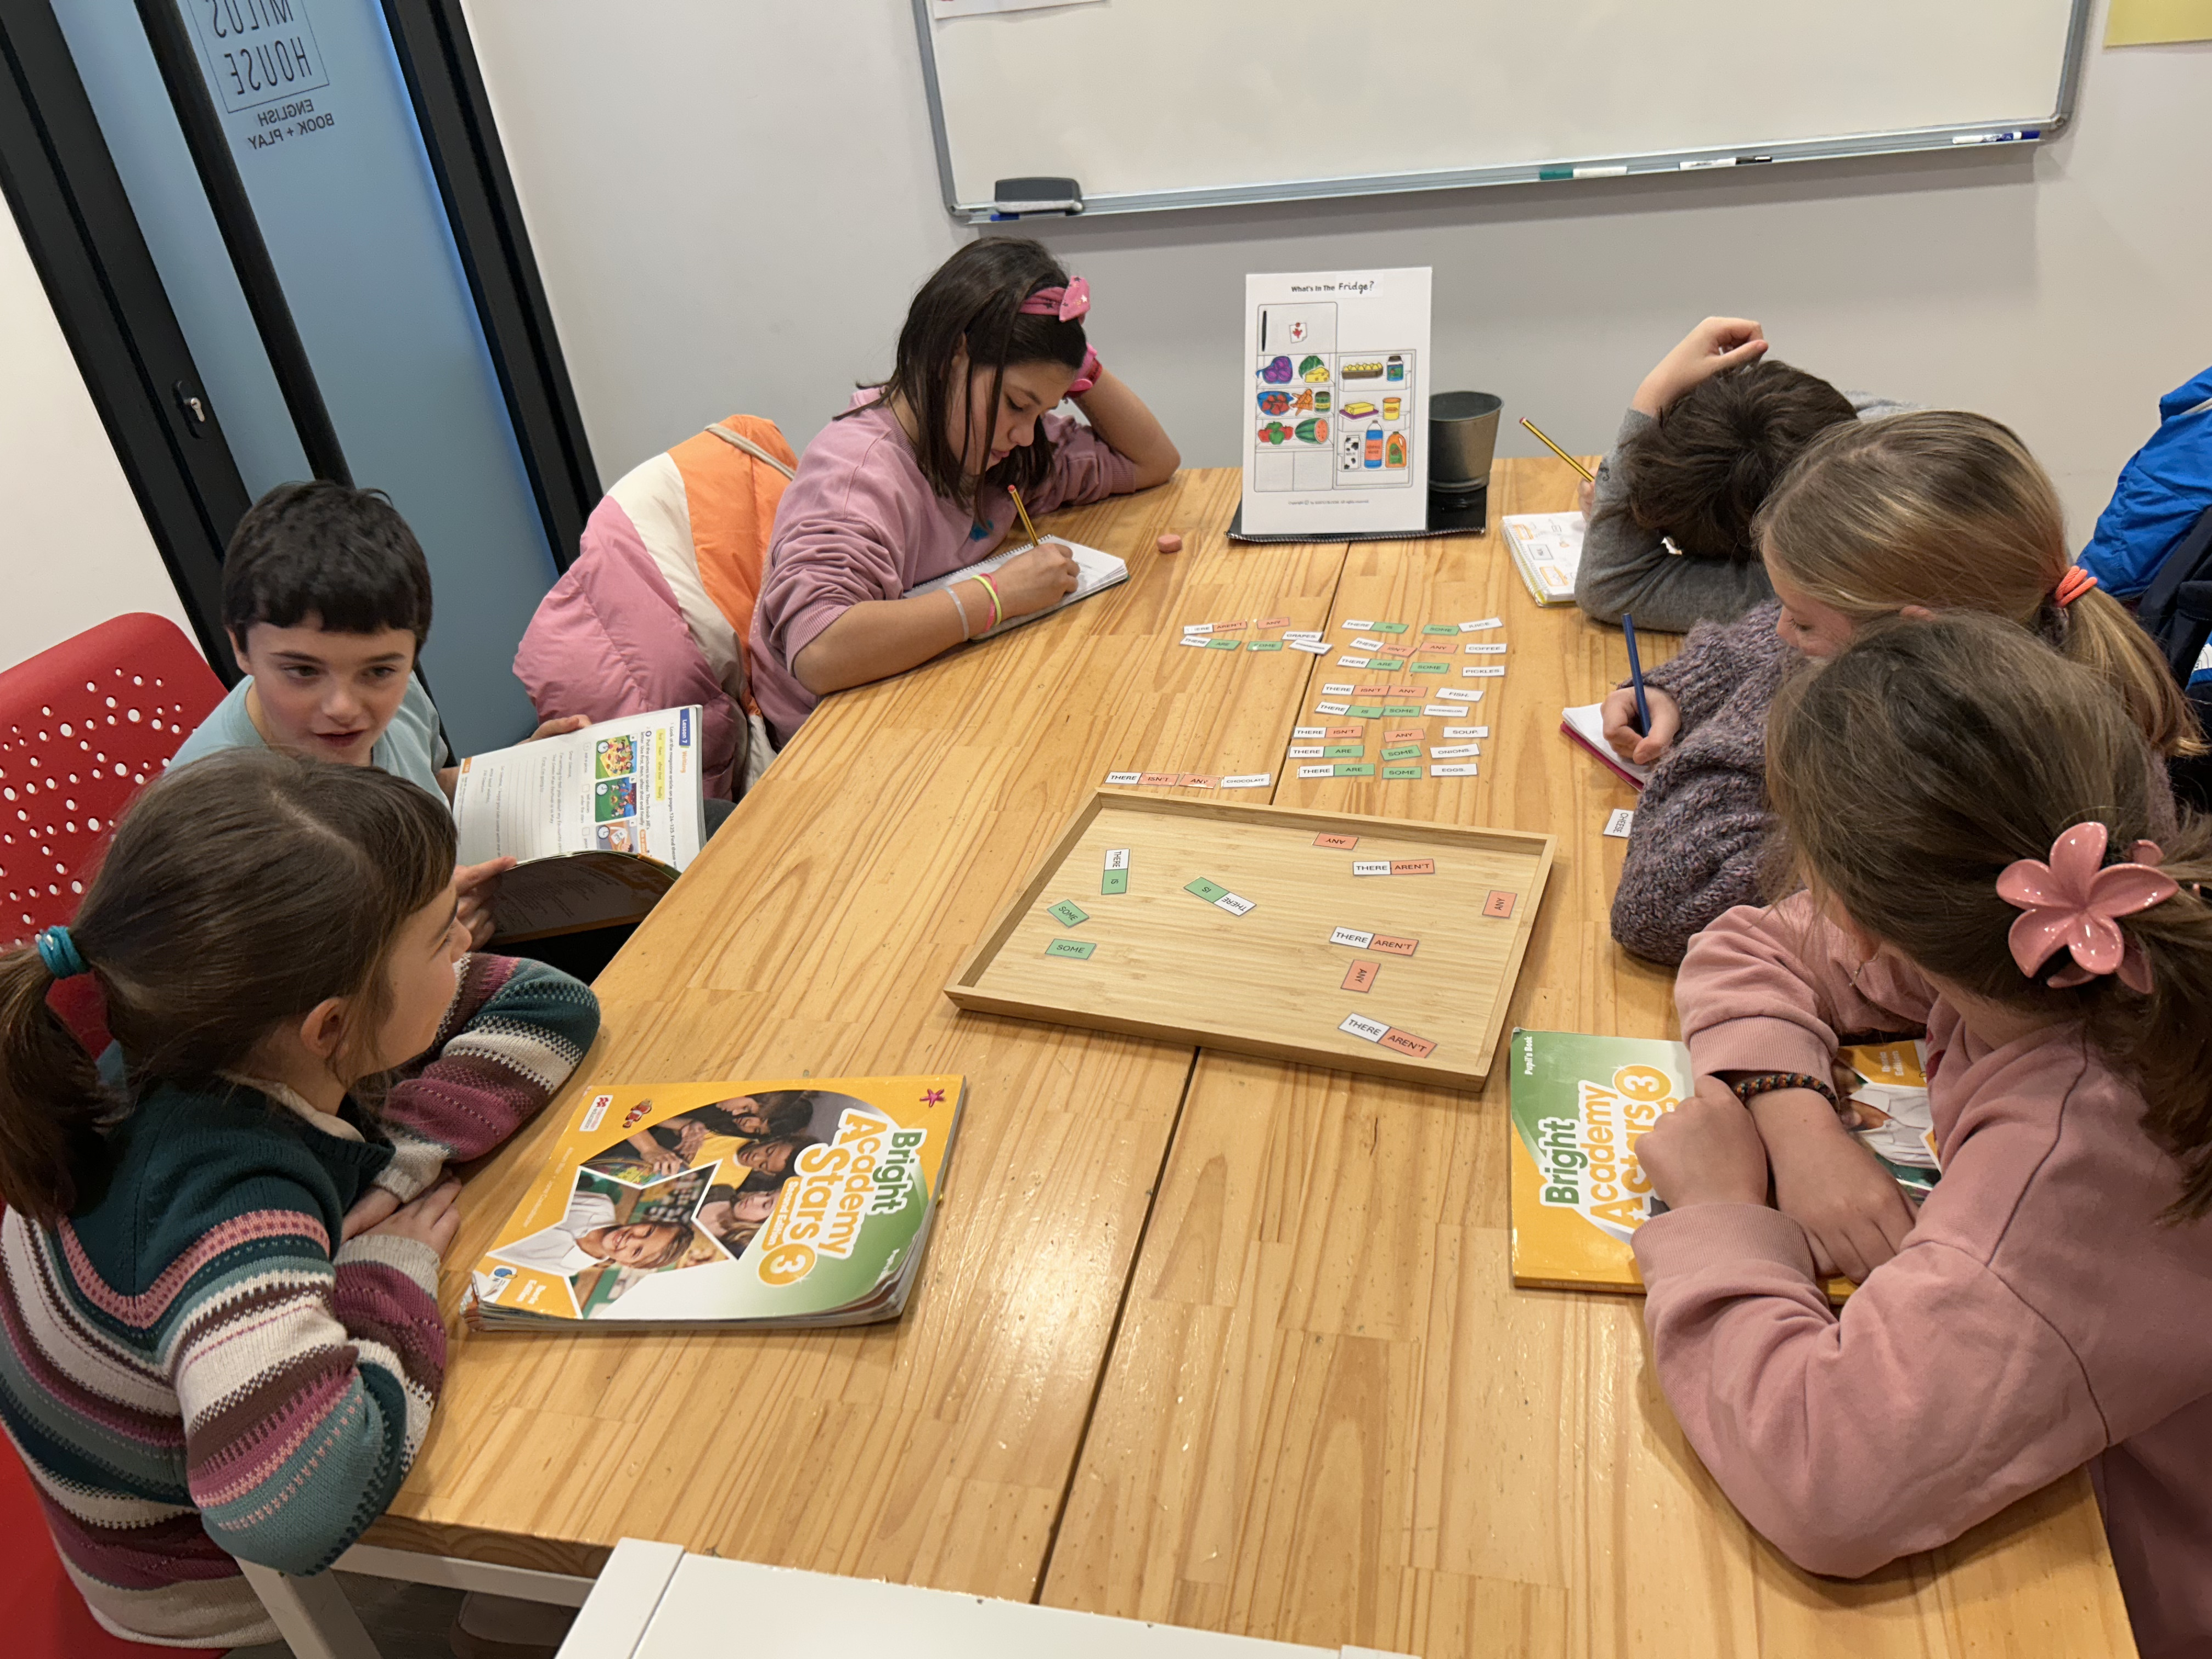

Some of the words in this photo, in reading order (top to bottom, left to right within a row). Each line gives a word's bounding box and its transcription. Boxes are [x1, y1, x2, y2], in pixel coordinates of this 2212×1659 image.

[1339, 280, 1374, 295] Fridge?
[1113, 851, 1121, 867] THERE
[1221, 896, 1247, 911] THERE
[1494, 898, 1505, 910] ANY
[1058, 906, 1078, 921] SOME
[1057, 944, 1085, 953] SOME
[1336, 932, 1368, 943] THERE
[1374, 940, 1412, 950] AREN'T
[1355, 968, 1367, 983] ANY
[1348, 1019, 1381, 1036] THERE
[1387, 1035, 1427, 1052] AREN'T
[1524, 1036, 1532, 1051] Book
[1524, 1053, 1535, 1075] Pupil's
[1623, 1076, 1660, 1092] 3
[1544, 1121, 1588, 1204] Bright
[1580, 1085, 1647, 1229] Academy
[872, 1132, 922, 1212] Bright
[818, 1113, 888, 1254] Academy
[782, 1181, 799, 1212] Second
[790, 1148, 850, 1240] Stars
[768, 1214, 787, 1245] Edition
[770, 1255, 806, 1273] 3
